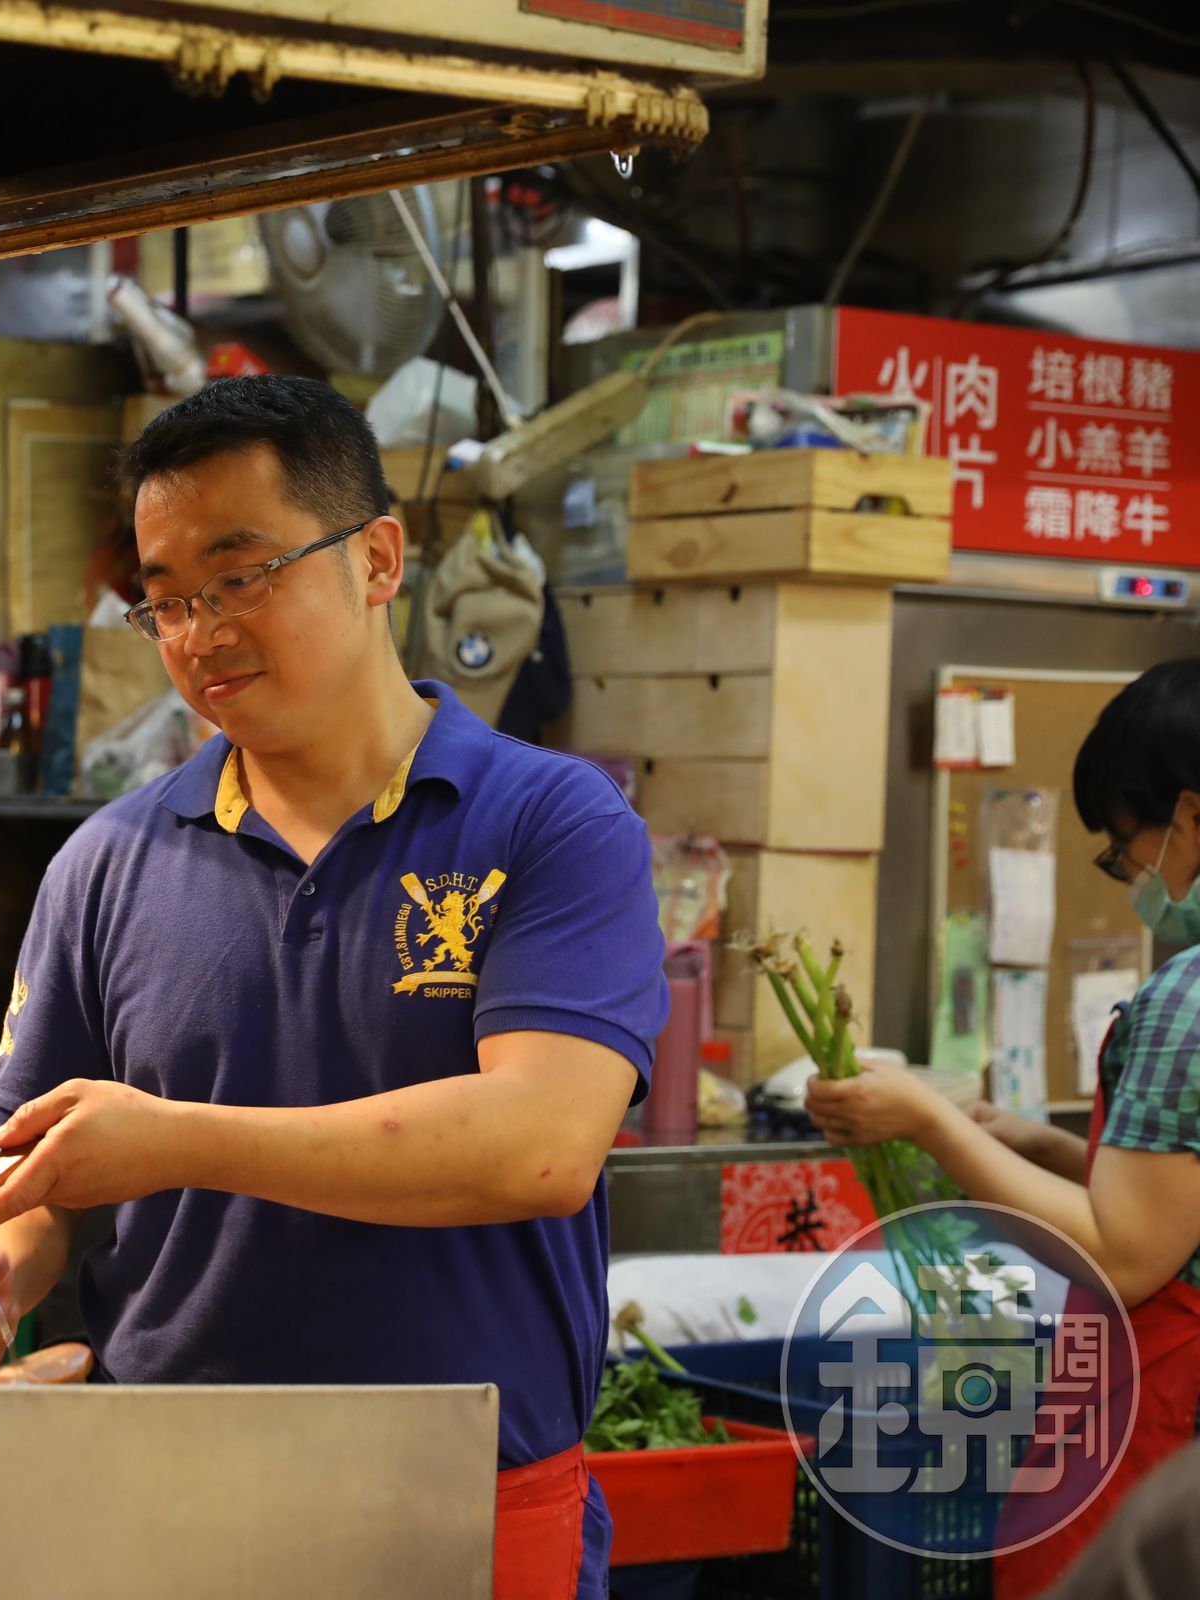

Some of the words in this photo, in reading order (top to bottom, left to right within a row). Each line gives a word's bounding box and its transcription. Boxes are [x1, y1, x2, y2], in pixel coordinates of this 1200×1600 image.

[1028, 346, 1173, 411] 培根豬
[944, 354, 998, 508] 肉片
[1026, 418, 1171, 475] 小羔羊
[1024, 487, 1170, 545] 霜降牛
[423, 987, 472, 998] SKIPPER
